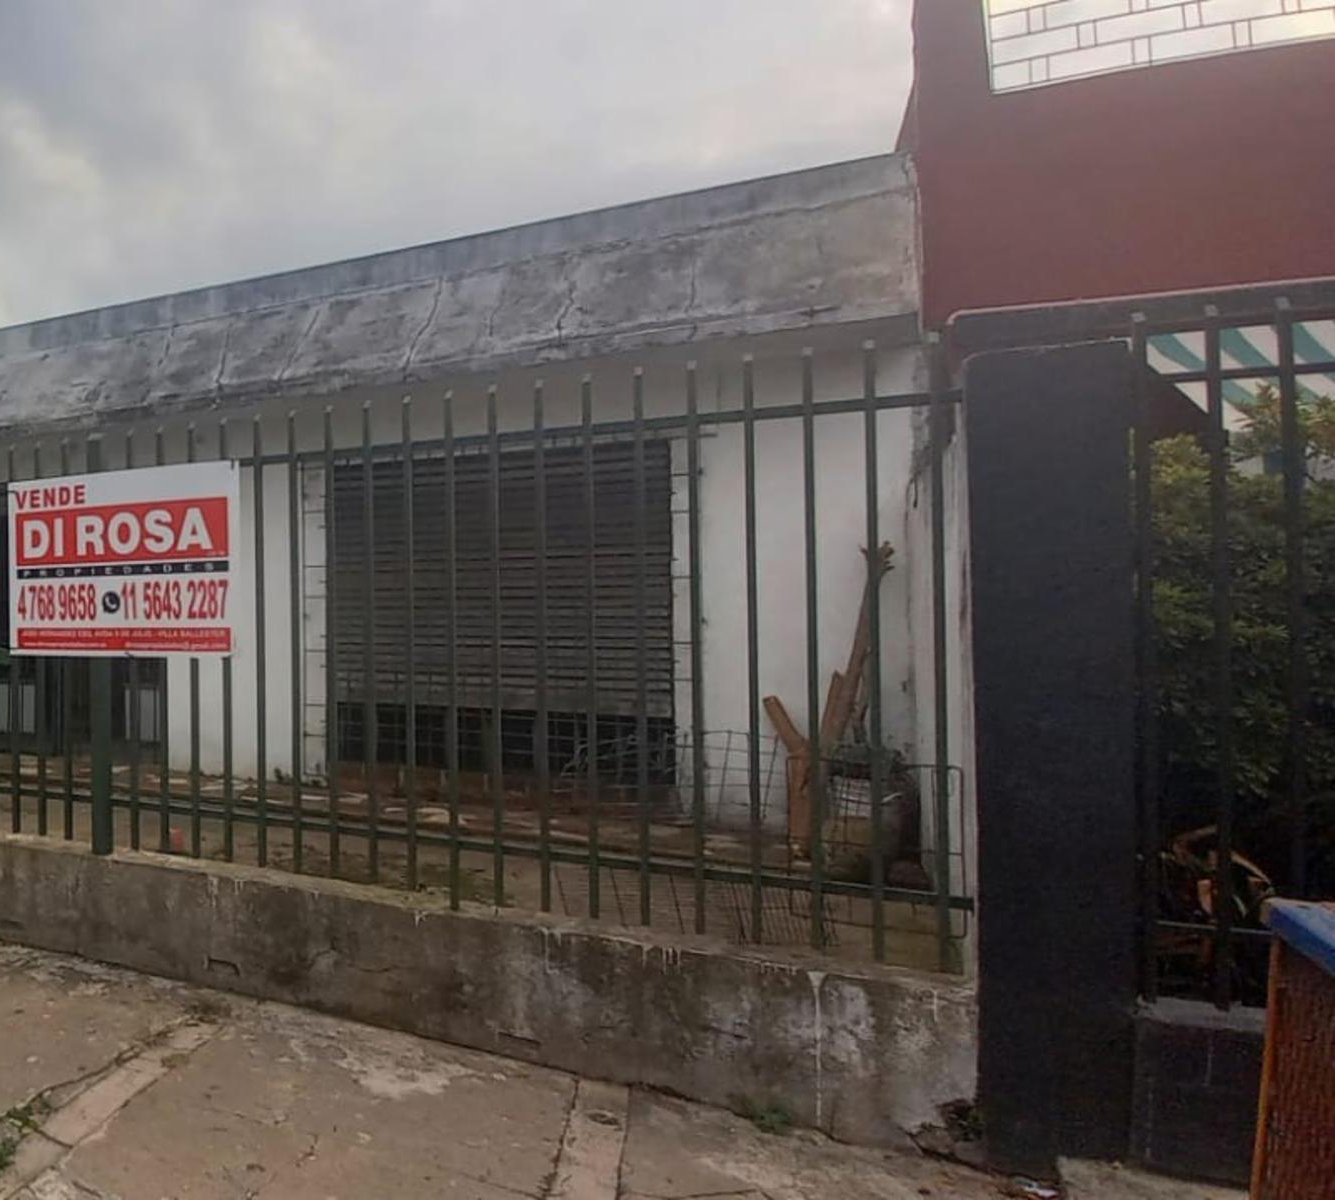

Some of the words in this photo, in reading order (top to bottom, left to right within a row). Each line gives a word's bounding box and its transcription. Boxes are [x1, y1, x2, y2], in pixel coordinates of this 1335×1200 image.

[17, 485, 85, 509] VENDE
[23, 518, 63, 559] DI
[76, 507, 213, 556] ROSA
[23, 563, 214, 577] PROPIEDADES
[17, 585, 55, 620] 4768
[59, 583, 96, 620] 9658
[121, 582, 137, 620] 11
[144, 581, 182, 620] 5643
[187, 579, 228, 620] 2287
